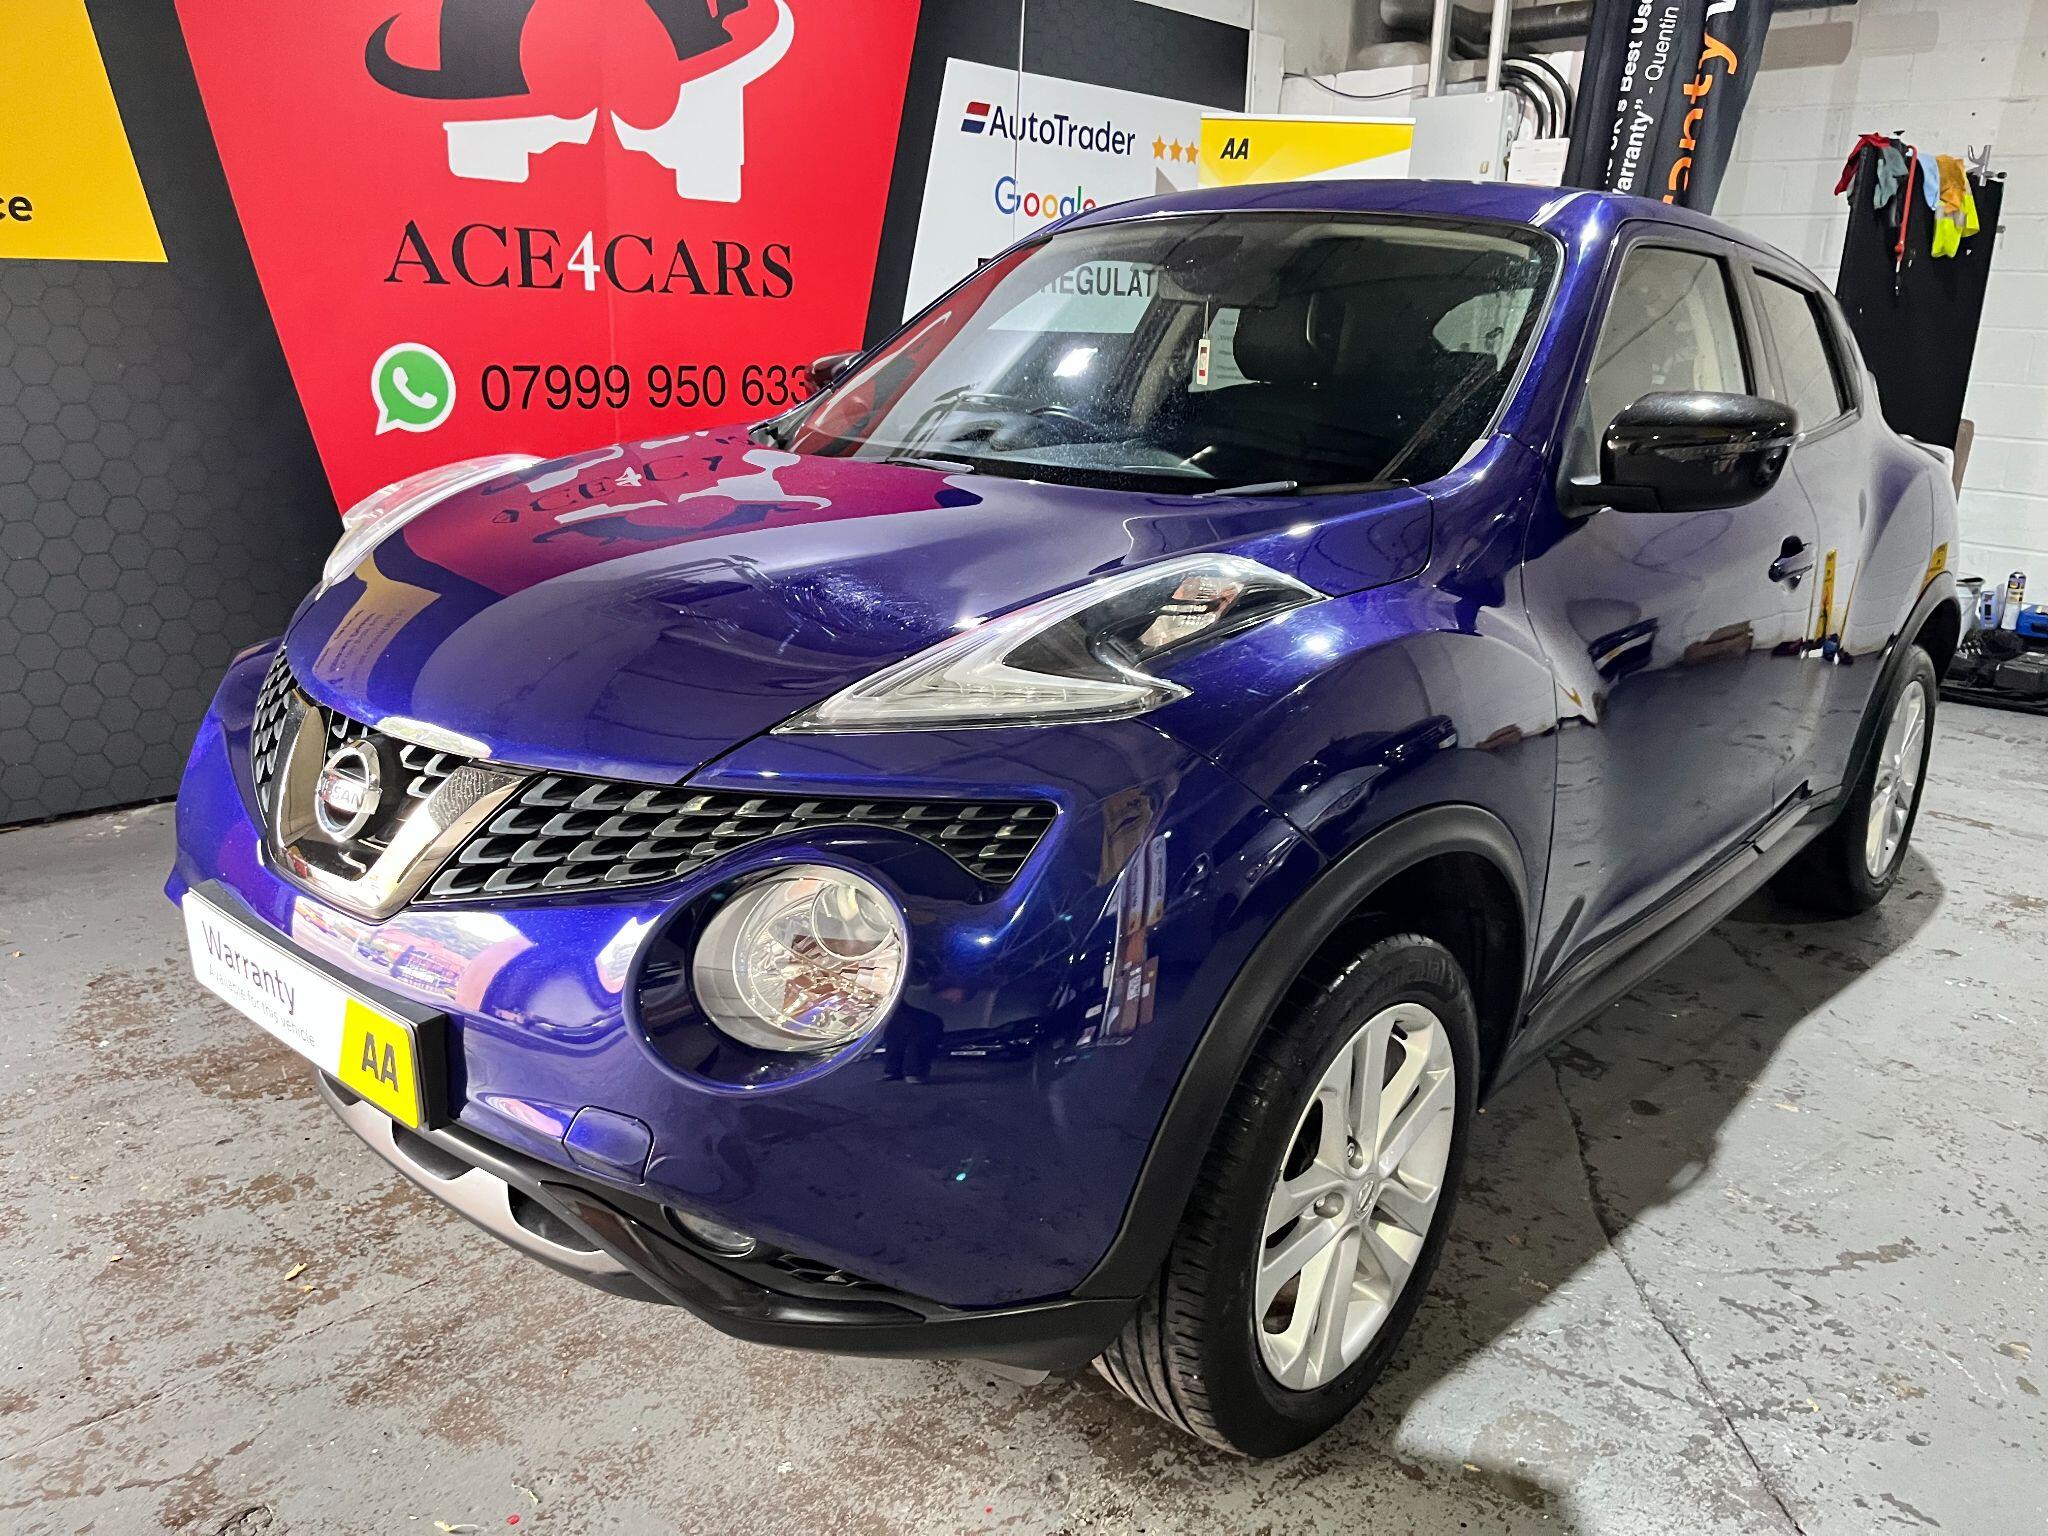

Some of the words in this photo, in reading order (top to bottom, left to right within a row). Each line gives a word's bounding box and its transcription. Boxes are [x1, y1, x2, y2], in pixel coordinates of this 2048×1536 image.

[1620, 41, 1643, 92] Best
[1612, 98, 1655, 195] arranty”
[1644, 6, 1680, 82] Quentin
[1662, 31, 1738, 205] anty
[990, 105, 1136, 157] AutoTrader
[1219, 137, 1249, 161] AA
[384, 219, 794, 299] ACE4CARS
[481, 363, 630, 412] 07999
[647, 363, 727, 408] 950
[201, 920, 296, 1015] Warranty
[261, 1000, 279, 1023] this
[280, 1017, 316, 1047] vehicle
[361, 1031, 400, 1093] AA
